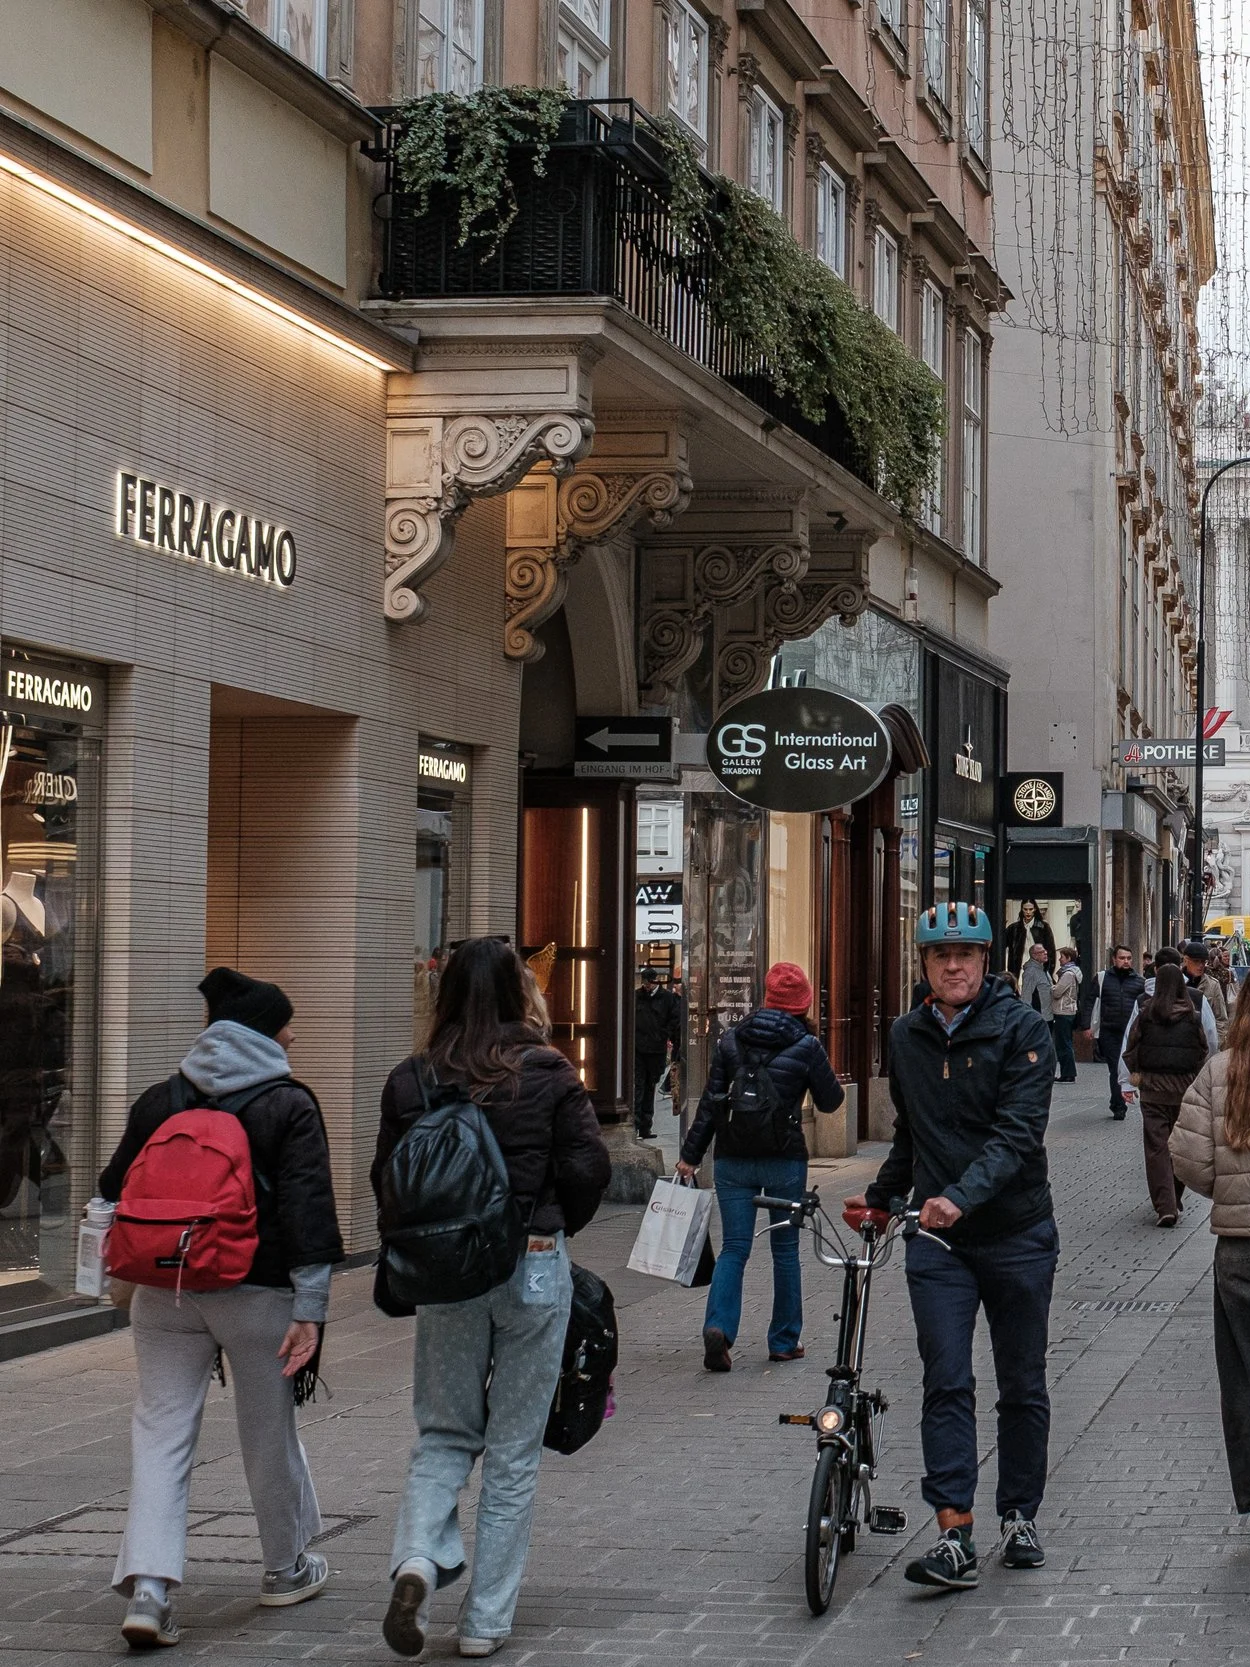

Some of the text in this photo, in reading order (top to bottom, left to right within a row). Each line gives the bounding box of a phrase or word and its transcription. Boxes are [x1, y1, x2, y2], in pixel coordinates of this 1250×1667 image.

[118, 472, 297, 586] FERRAGAMO
[8, 670, 92, 712] FERRAGAMO
[717, 723, 767, 757] GS
[775, 731, 877, 747] International
[419, 754, 466, 783] FERRAGAMO
[581, 764, 665, 774] EINGANG IM HOF
[722, 758, 761, 766] GALLERY
[785, 753, 867, 770] Glass Art
[721, 767, 761, 776] SIKABONYI
[1017, 781, 1034, 798] STONE
[1036, 781, 1053, 799] ISLAND
